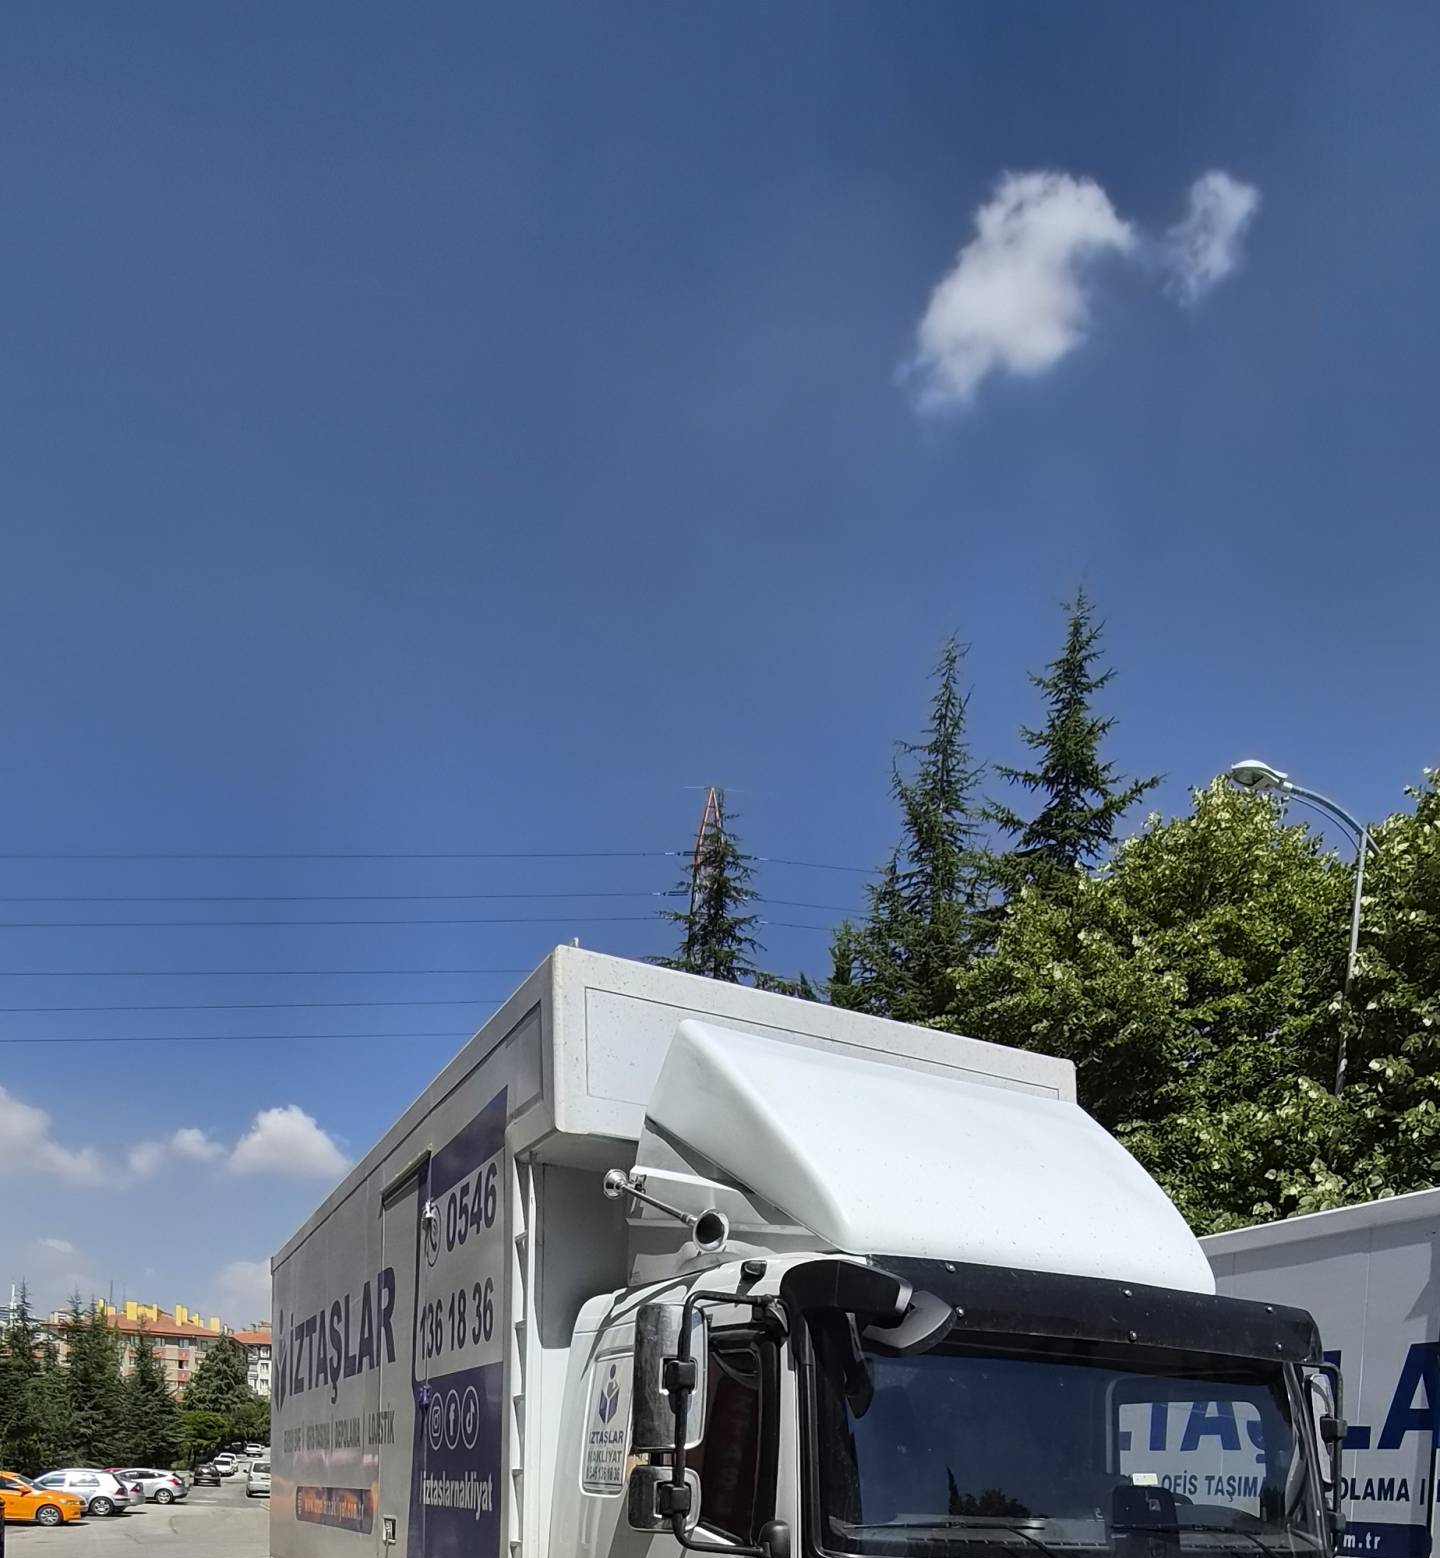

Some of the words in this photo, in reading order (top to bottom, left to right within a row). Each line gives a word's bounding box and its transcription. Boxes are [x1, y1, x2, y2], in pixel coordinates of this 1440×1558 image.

[446, 1162, 498, 1252] 0546
[289, 1266, 396, 1405] İZTAŞLAR
[420, 1299, 443, 1361] 136
[448, 1288, 467, 1351] 18
[471, 1277, 494, 1346] 36
[1161, 1470, 1198, 1496] OFİS
[1340, 1476, 1410, 1502] OLAMA
